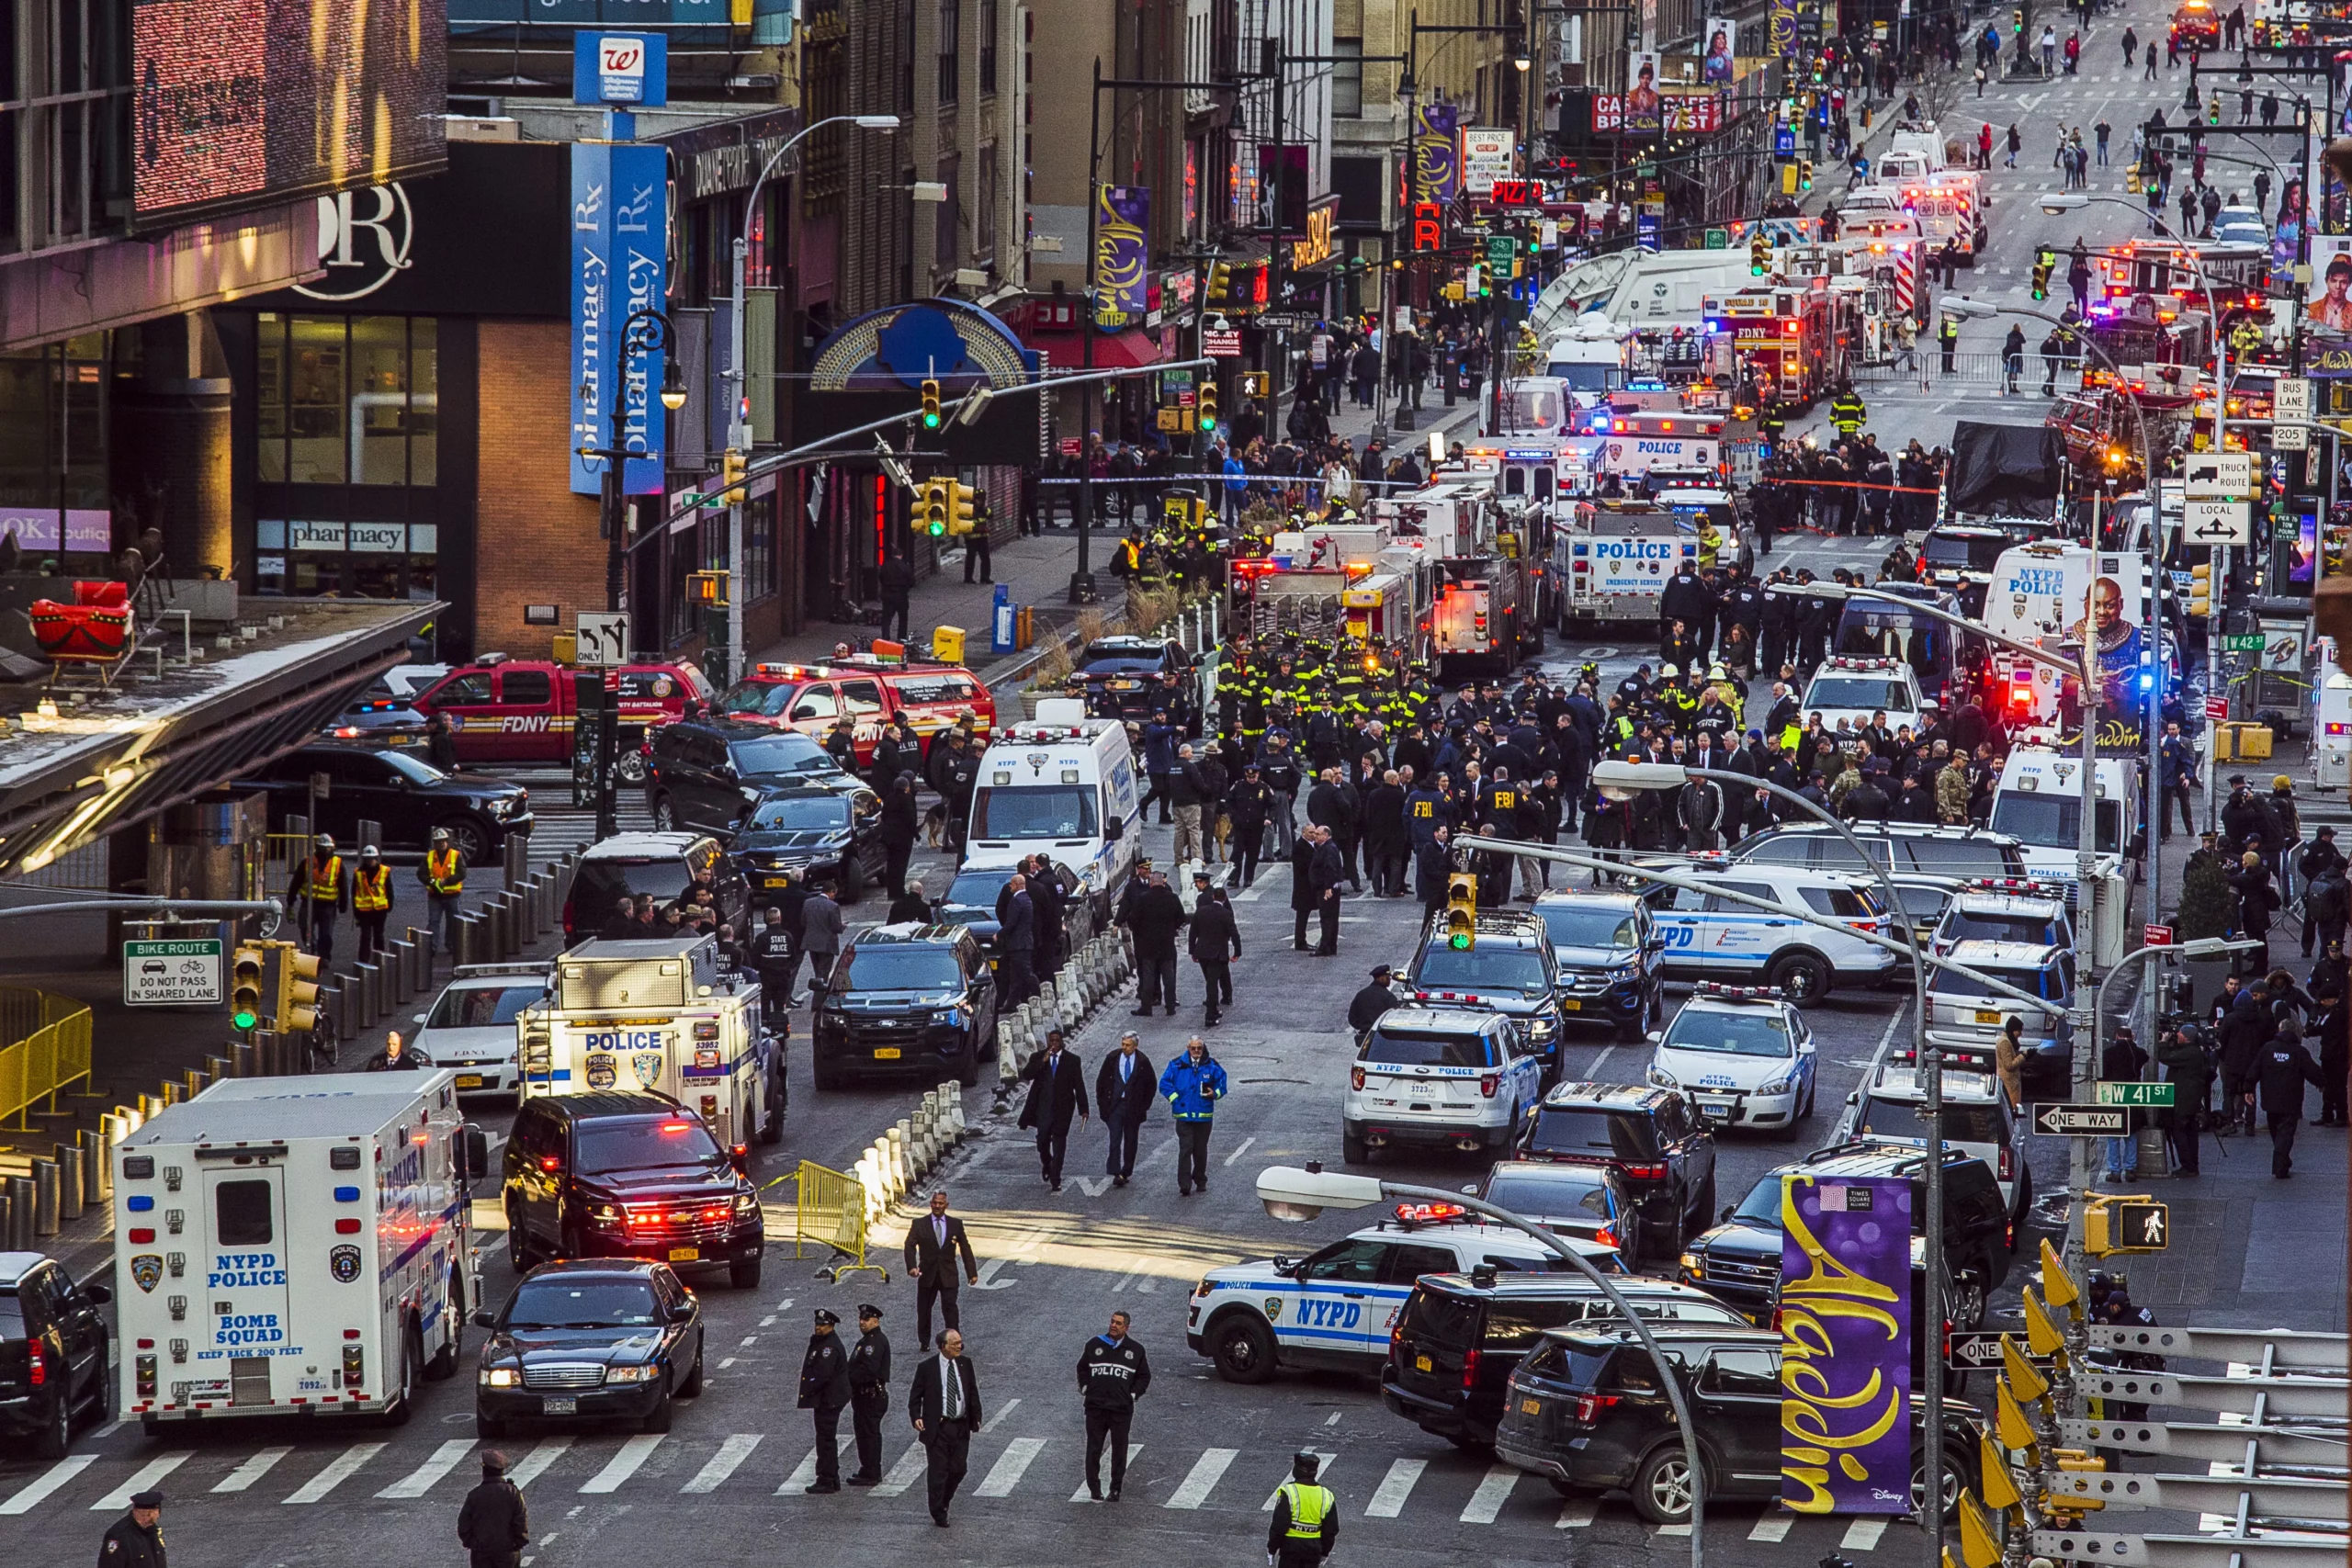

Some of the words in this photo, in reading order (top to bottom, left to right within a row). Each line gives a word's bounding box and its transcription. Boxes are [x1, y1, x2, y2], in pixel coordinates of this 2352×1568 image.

[1468, 133, 1486, 142] BEST
[1487, 133, 1506, 142] PRICE
[1417, 103, 1453, 204] Aladdin
[576, 182, 603, 231] Rx
[617, 183, 653, 235] Rx
[1098, 183, 1144, 312] Aladdin
[1302, 310, 1319, 319] Club
[1738, 328, 1766, 338] FDNY
[2283, 383, 2301, 393] BUS
[2279, 397, 2303, 406] LANE
[1638, 441, 1682, 454] POLICE
[1729, 443, 1757, 453] POLICE
[2221, 463, 2247, 472] TRUCK
[2220, 478, 2246, 487] ROUTE
[2055, 499, 2064, 522] NYP
[2200, 506, 2233, 514] LOCAL
[292, 524, 402, 548] pharmacy
[1596, 543, 1671, 558] POLICE
[2008, 580, 2063, 596] POLIC
[2230, 637, 2238, 649] W
[2240, 637, 2254, 649] 42
[578, 652, 601, 661] ONLY
[502, 716, 550, 732] FDNY
[1495, 791, 1515, 808] FBI
[1414, 801, 1433, 817] FBI
[770, 935, 786, 944] STATE
[137, 943, 165, 954] BIKE
[172, 942, 209, 953] ROUTE
[769, 944, 788, 953] POLICE
[140, 977, 155, 987] DO
[162, 977, 177, 987] NOT
[180, 976, 207, 986] PASS
[131, 990, 141, 999] IN
[144, 989, 186, 999] SHARED
[188, 988, 217, 998] LANE
[585, 1032, 662, 1051] POLICE
[587, 1056, 615, 1066] POLICE
[2273, 1052, 2290, 1060] NYPD
[1375, 1064, 1403, 1073] NYPD
[1438, 1066, 1475, 1076] POLICE
[1410, 1085, 1429, 1093] 3723
[1699, 1078, 1736, 1088] POLICE
[2113, 1086, 2126, 1103] W
[2132, 1086, 2151, 1103] 41
[2154, 1086, 2167, 1096] ST
[1703, 1105, 1723, 1113] 4370
[2049, 1114, 2075, 1126] ONE
[2087, 1114, 2117, 1127] WAY
[386, 1149, 419, 1204] POLICE
[332, 1245, 359, 1257] POLICE
[217, 1253, 277, 1270] NYPD
[208, 1269, 287, 1289] POLICE
[1226, 1281, 1251, 1290] POLICE
[1296, 1298, 1361, 1329] NYPD
[220, 1314, 278, 1330] BOMB
[215, 1328, 283, 1346] SQUAD
[1781, 1174, 1900, 1515] Aladdin
[1967, 1343, 1997, 1358] ONE
[197, 1350, 223, 1359] KEEP
[226, 1349, 254, 1359] BACK
[257, 1348, 276, 1357] 200
[278, 1347, 304, 1357] FEET
[1091, 1366, 1129, 1380] POLICE
[299, 1380, 321, 1390] 7092
[1870, 1487, 1905, 1504] Disney
